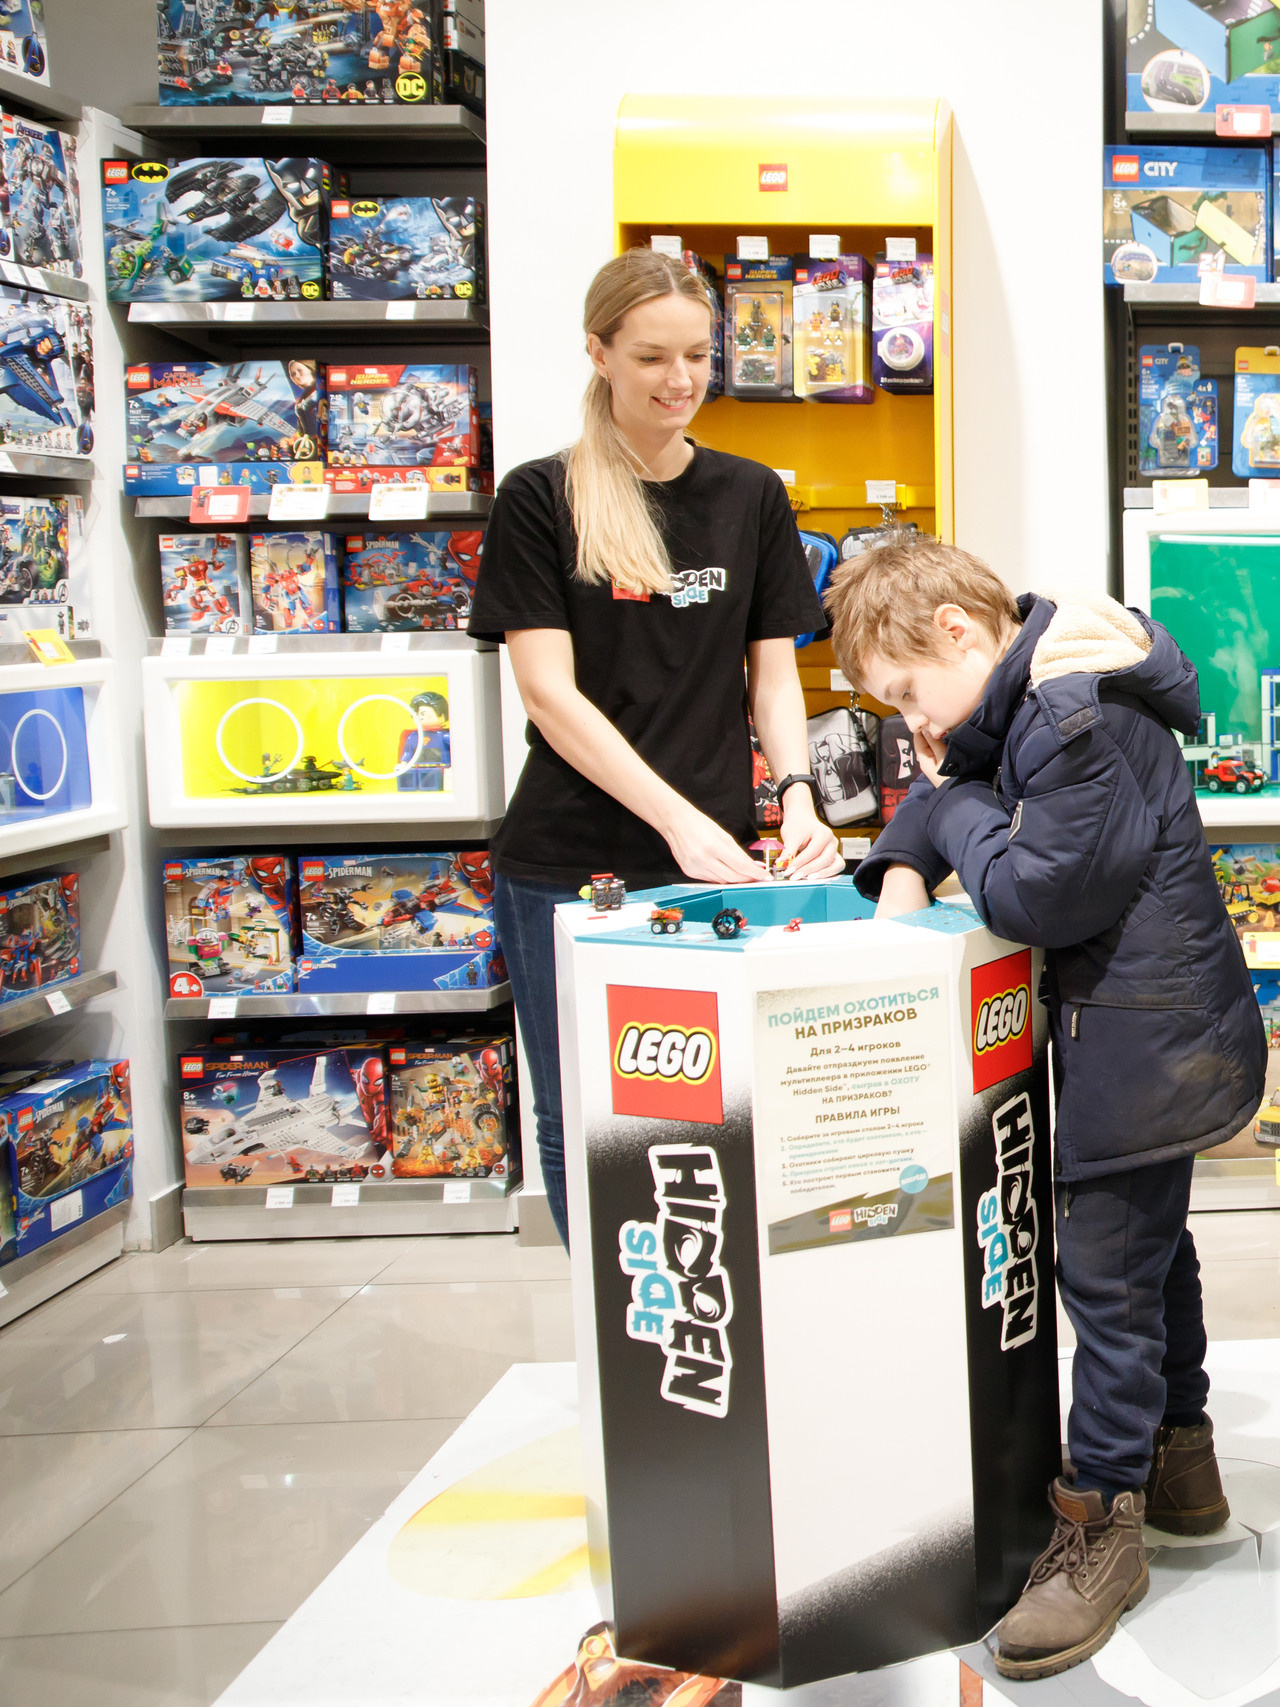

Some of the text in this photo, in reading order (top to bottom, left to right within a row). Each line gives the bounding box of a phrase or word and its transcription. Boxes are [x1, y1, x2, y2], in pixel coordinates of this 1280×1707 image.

[398, 77, 425, 96] DC
[106, 168, 127, 178] LEGO
[1114, 162, 1178, 177] LEGO CITY
[760, 172, 786, 184] LEGO
[106, 188, 117, 196] 7+
[1114, 198, 1128, 209] 5+
[812, 270, 839, 284] LEGO
[302, 284, 320, 296] DC
[455, 284, 472, 295] DC
[129, 373, 149, 383] LEGO
[153, 378, 205, 388] MARVEL
[128, 400, 140, 409] 7+
[673, 588, 706, 606] SIDE
[167, 868, 182, 876] LEGO
[305, 866, 323, 876] LEGO
[305, 912, 318, 921] 7+
[173, 976, 200, 995] 4+
[768, 987, 939, 1028] ПОЙДЕМ ОХОТИТЬСЯ
[795, 1008, 917, 1040] НА ПРИЗРАКОВ
[976, 988, 1028, 1050] LEGO
[617, 1024, 714, 1082] LEGO
[810, 1047, 831, 1057] Для
[858, 1041, 901, 1052] игроков
[183, 1061, 270, 1072] LEGO SPIDER-MAN
[786, 1054, 925, 1074] Давайте отпразднуем появление
[780, 1074, 841, 1086] мультиплеера
[850, 1068, 902, 1079] приложении
[793, 1086, 822, 1096] Hidden
[852, 1080, 882, 1090] сыграв
[891, 1076, 920, 1085] ОХОТУ
[182, 1092, 196, 1100] 8+
[836, 1090, 893, 1103] ПРИЗРАКОВ?
[816, 1106, 900, 1124] ПРАВИЛА ИГРЫ
[787, 1121, 924, 1142] Соберите игровым столом игрока
[790, 1147, 914, 1168] Охотники собирают цирковую пушку
[836, 1171, 862, 1181] первым
[831, 1204, 898, 1225] LEGO HIDDEN
[996, 1097, 1037, 1349] HIDDEN
[980, 1193, 1007, 1302] SIDE
[624, 1226, 677, 1338] SIDE
[653, 1148, 729, 1412] HIDDEN
